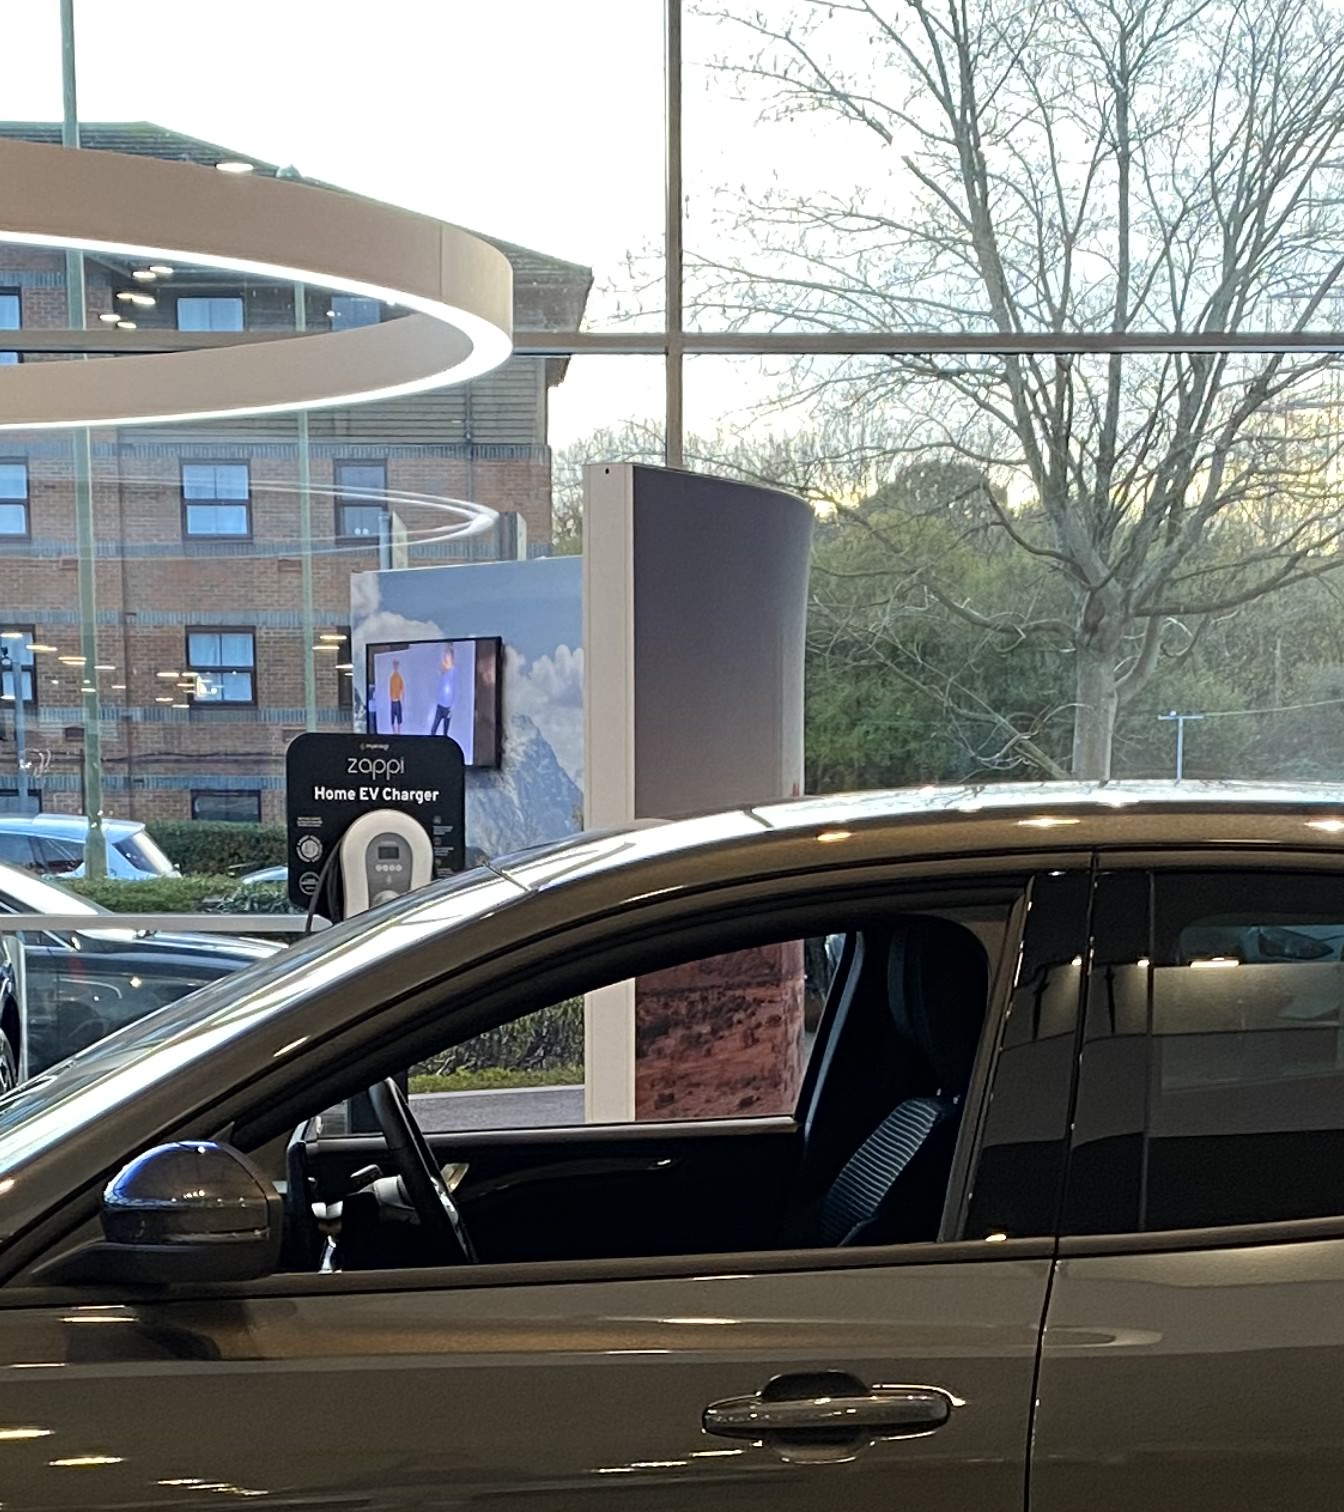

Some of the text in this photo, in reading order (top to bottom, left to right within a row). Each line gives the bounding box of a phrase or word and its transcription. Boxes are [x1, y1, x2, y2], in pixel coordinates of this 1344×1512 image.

[347, 757, 405, 780] zappi
[314, 786, 440, 805] Home EV Charger
